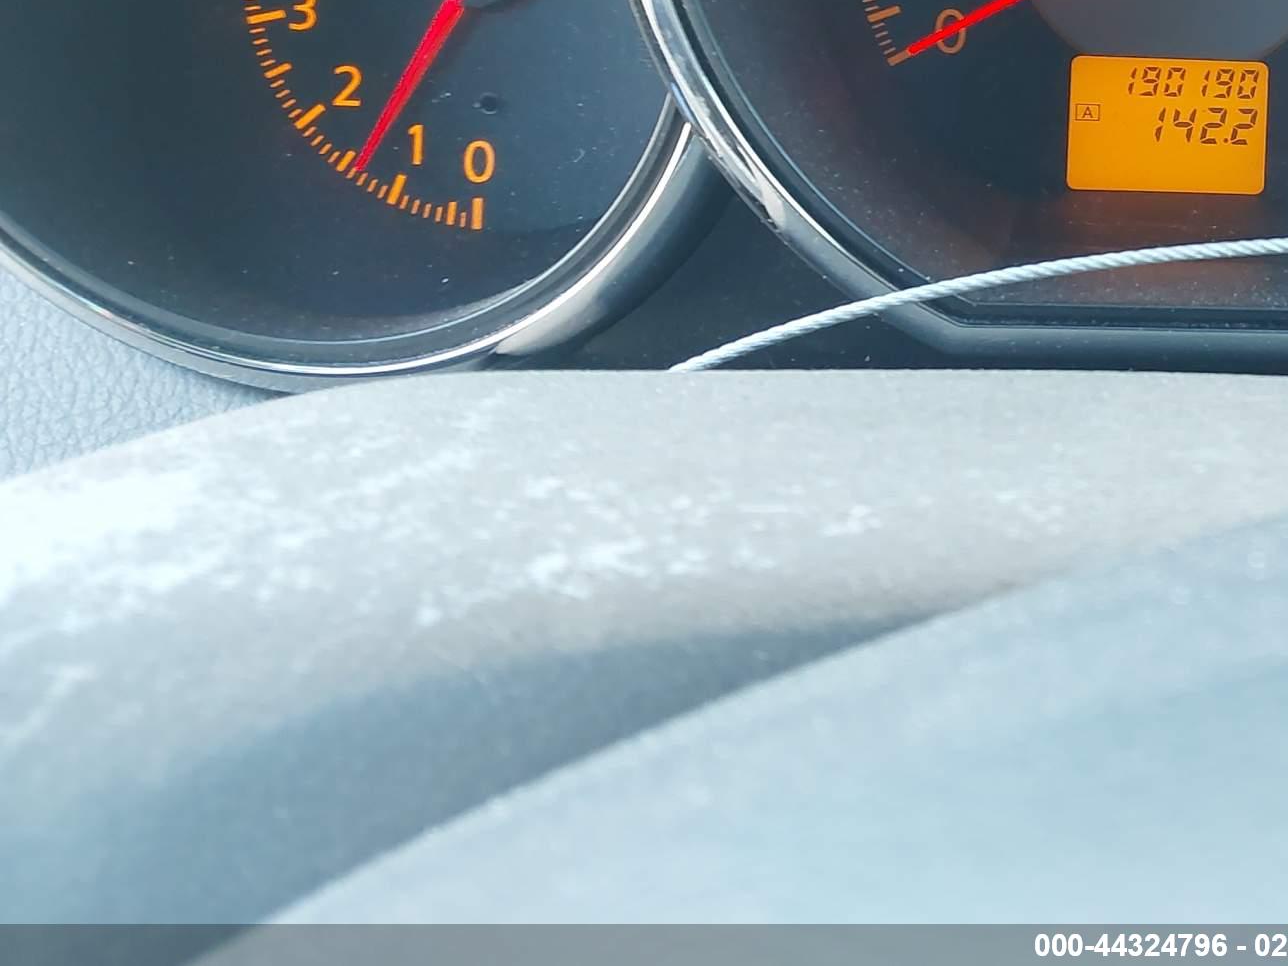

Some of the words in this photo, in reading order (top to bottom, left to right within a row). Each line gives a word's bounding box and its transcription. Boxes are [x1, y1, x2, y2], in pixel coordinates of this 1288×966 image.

[935, 9, 967, 54] 0
[333, 66, 361, 107] 2
[1127, 66, 1259, 99] 190190
[408, 124, 424, 165] 1
[1154, 107, 1258, 145] 142.2
[464, 141, 495, 182] 0
